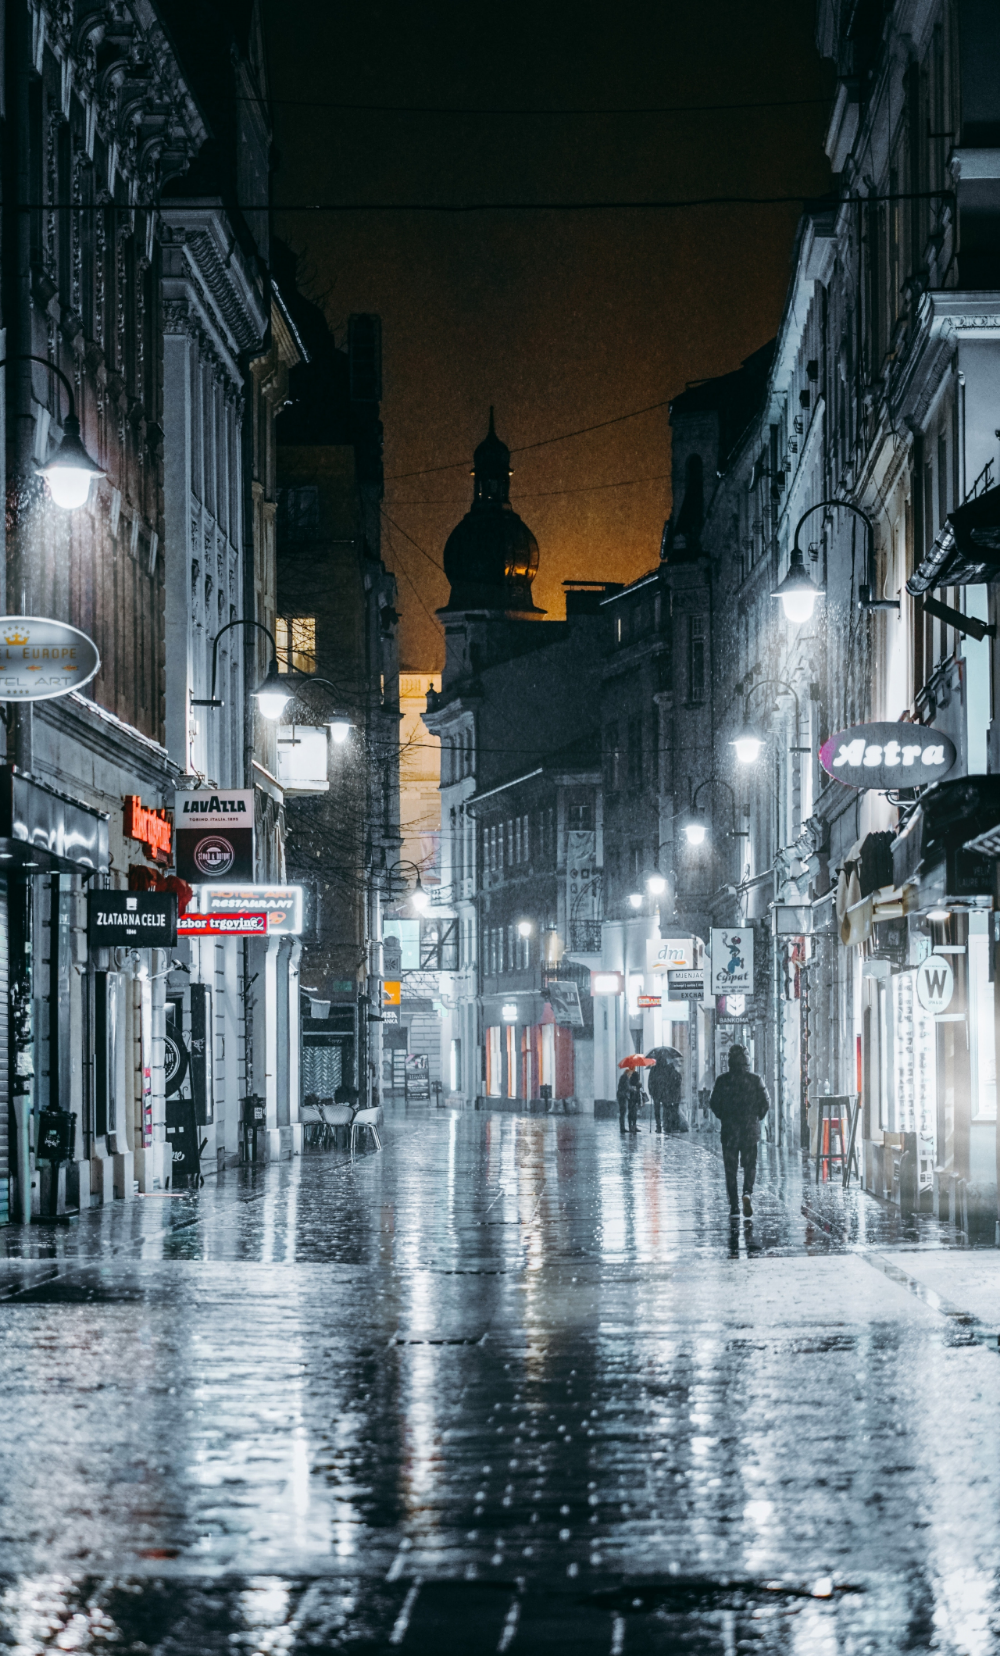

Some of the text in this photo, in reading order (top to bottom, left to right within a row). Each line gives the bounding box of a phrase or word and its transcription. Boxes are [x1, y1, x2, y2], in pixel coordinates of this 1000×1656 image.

[22, 648, 77, 660] EUROPE
[34, 677, 72, 687] ART
[832, 738, 946, 767] Astra
[182, 796, 247, 814] LAVAZZA
[211, 890, 293, 898] HOTEL ART
[96, 912, 166, 927] ZLATARNA CELJE
[176, 917, 258, 931] Izbor trgovine
[657, 944, 684, 960] dm
[924, 969, 948, 999] W
